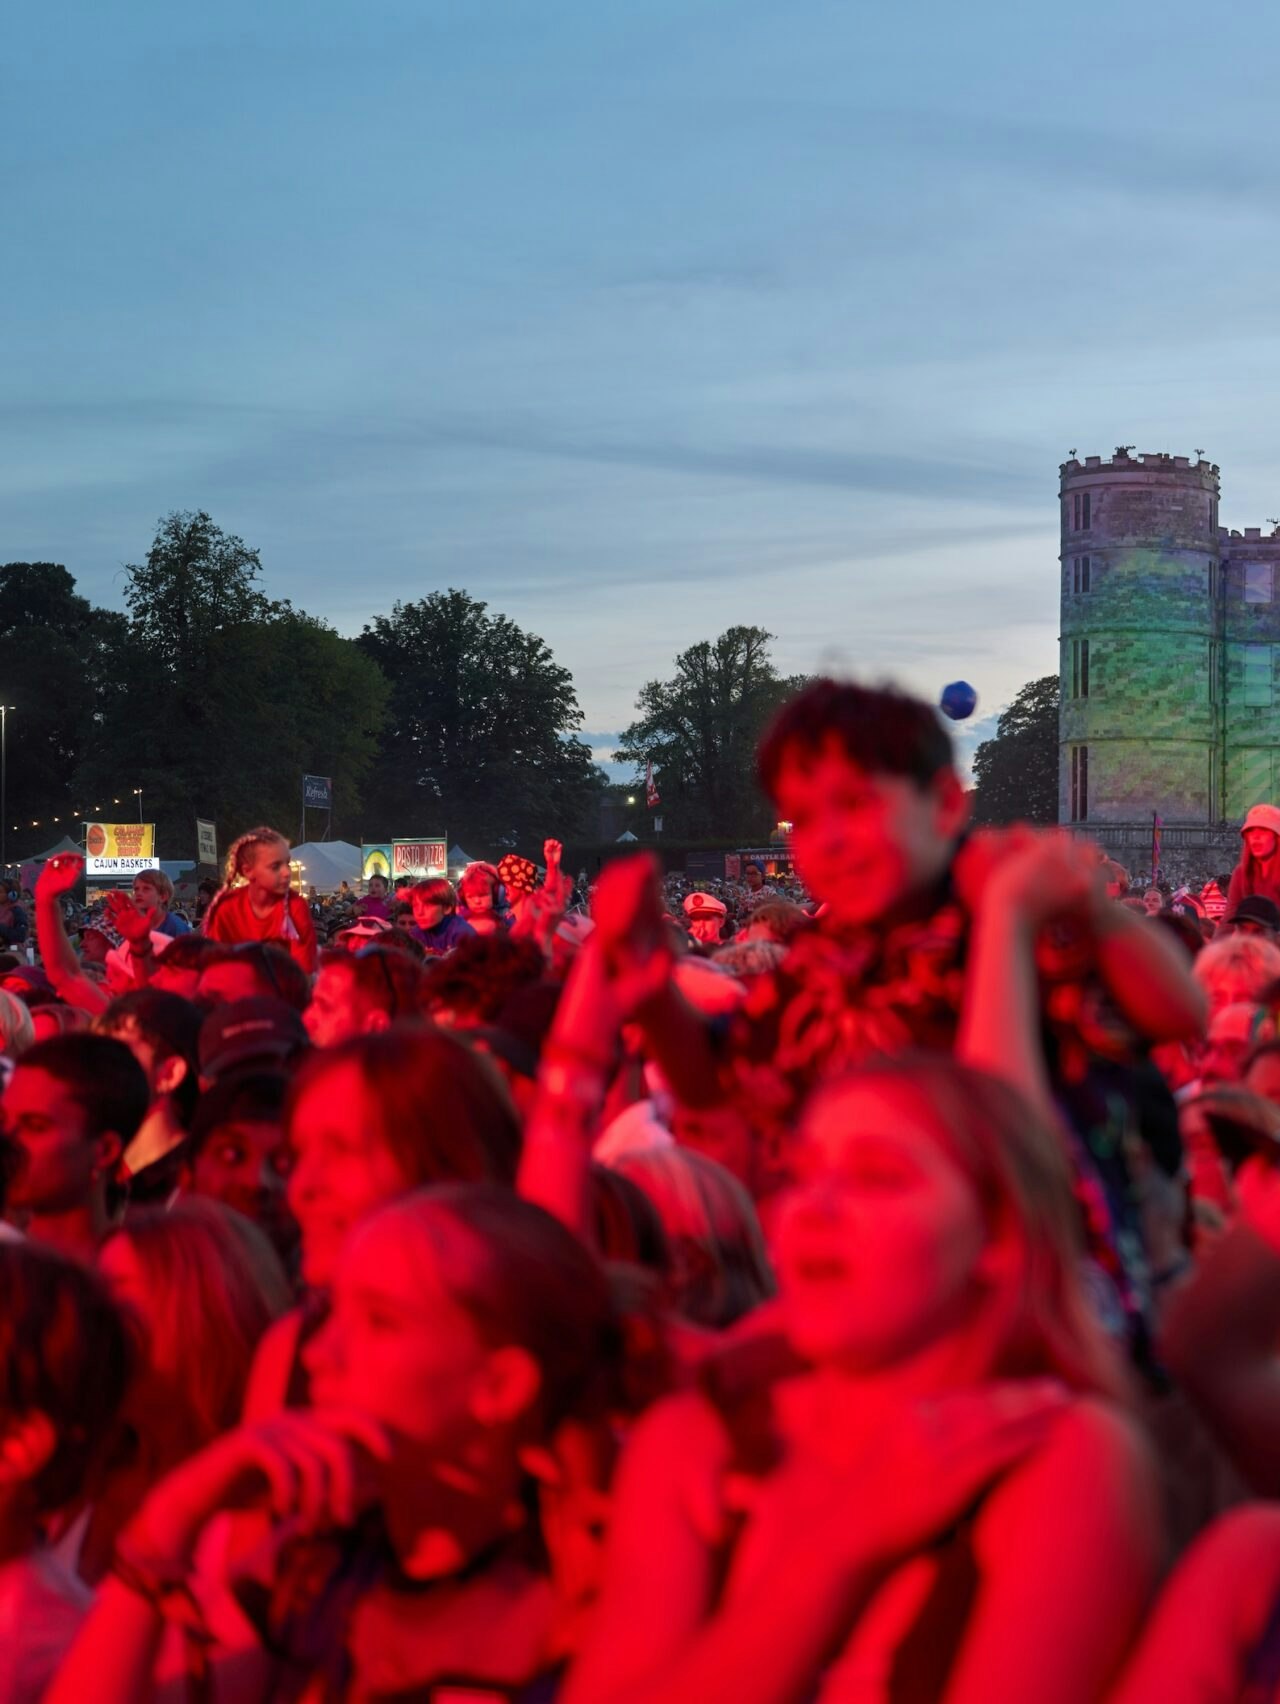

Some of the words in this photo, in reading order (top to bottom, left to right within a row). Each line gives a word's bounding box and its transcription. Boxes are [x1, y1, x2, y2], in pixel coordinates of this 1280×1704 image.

[305, 785, 328, 800] Refresh
[94, 858, 118, 868] CAJUN
[120, 858, 153, 868] BASKETS
[396, 845, 420, 866] PASTA
[424, 845, 444, 865] PIZZA
